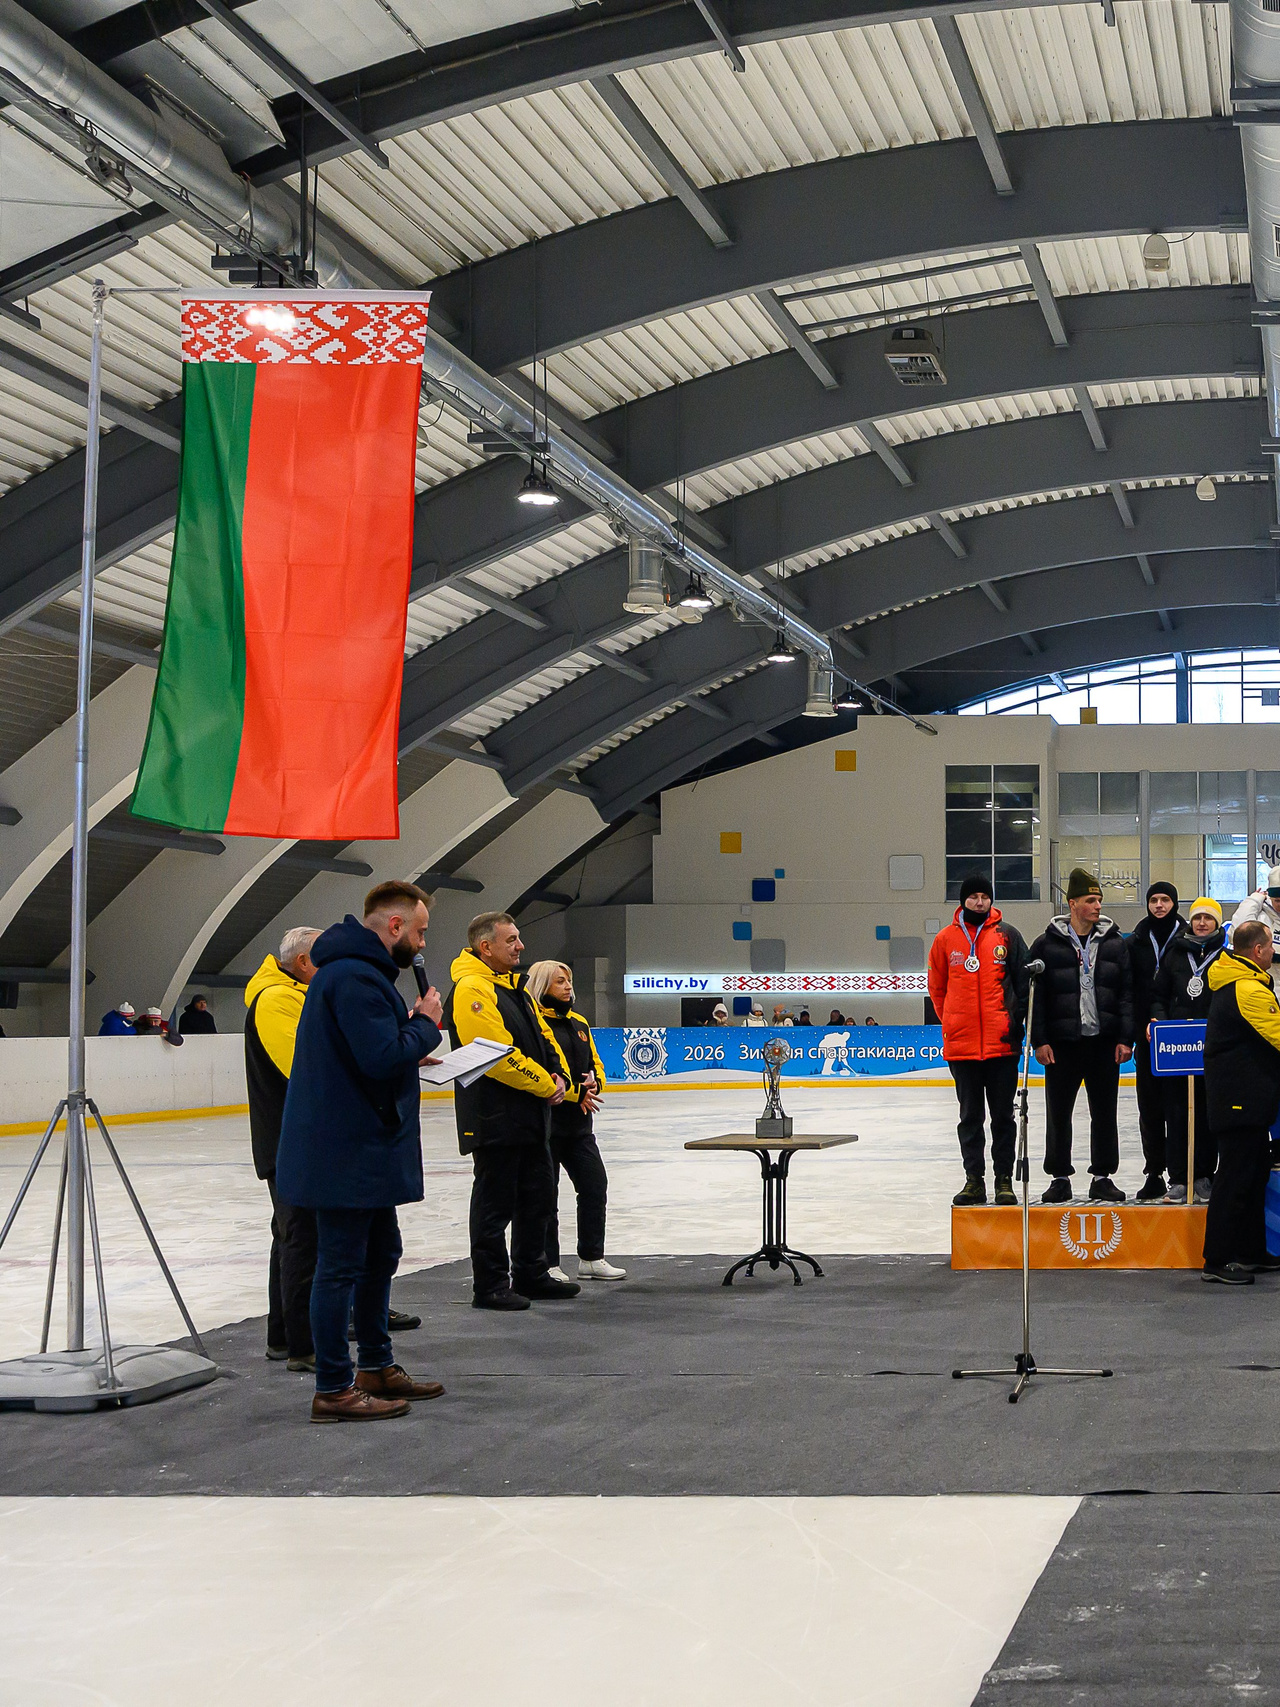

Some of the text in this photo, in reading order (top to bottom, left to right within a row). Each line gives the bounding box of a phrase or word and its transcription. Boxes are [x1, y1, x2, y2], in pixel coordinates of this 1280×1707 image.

[633, 977, 709, 990] silichy.by
[684, 1045, 725, 1061] 2026
[739, 1045, 804, 1060] Зия
[808, 1046, 916, 1061] спартакиада
[1159, 1040, 1204, 1055] Агрохолд
[507, 1056, 541, 1083] BELARUS
[1075, 1213, 1106, 1244] II
